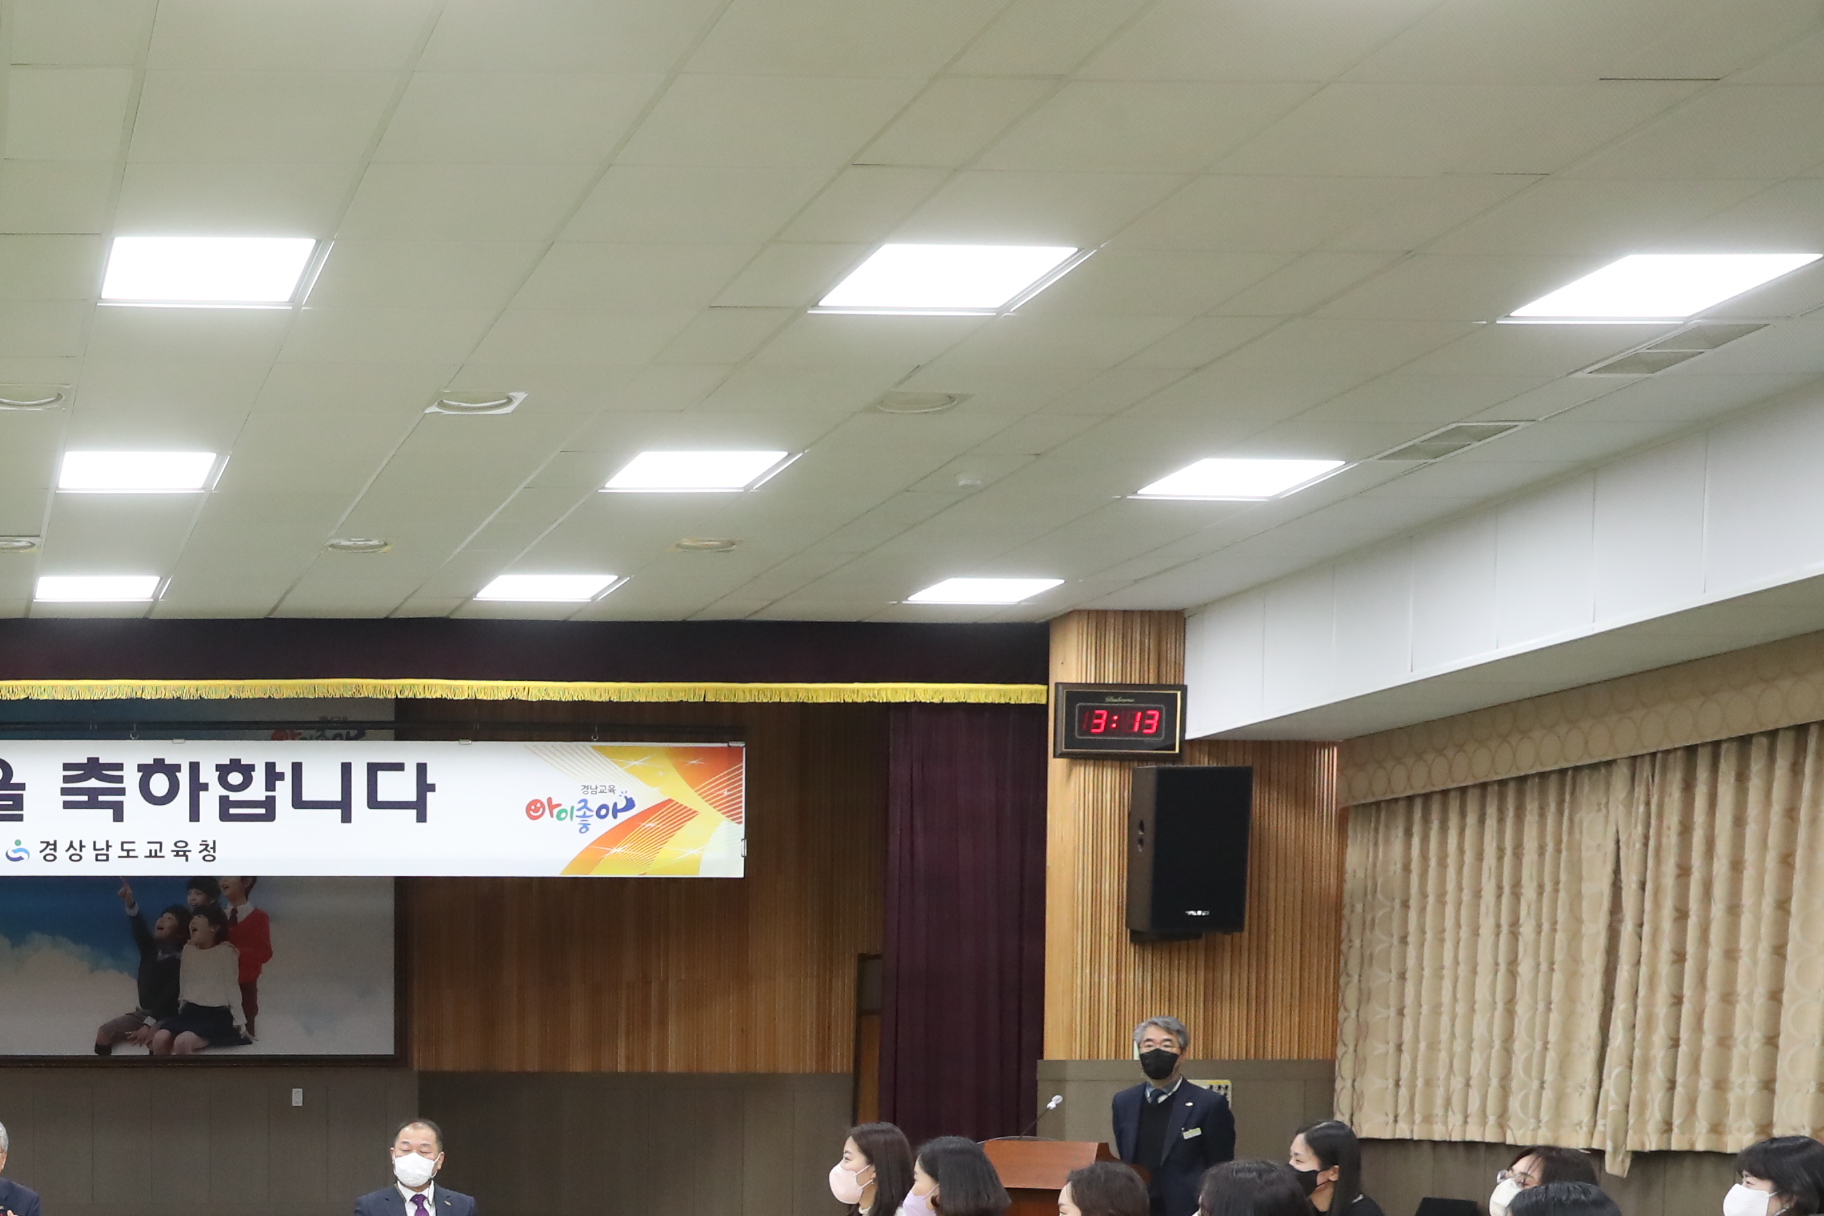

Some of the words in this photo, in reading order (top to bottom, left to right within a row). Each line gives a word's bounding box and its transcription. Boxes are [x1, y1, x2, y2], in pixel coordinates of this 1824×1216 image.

[60, 756, 436, 824] 축하합니다
[581, 784, 617, 796] 경남교육
[525, 796, 636, 834] 아이좋아
[39, 839, 218, 863] 경상남도교육청
